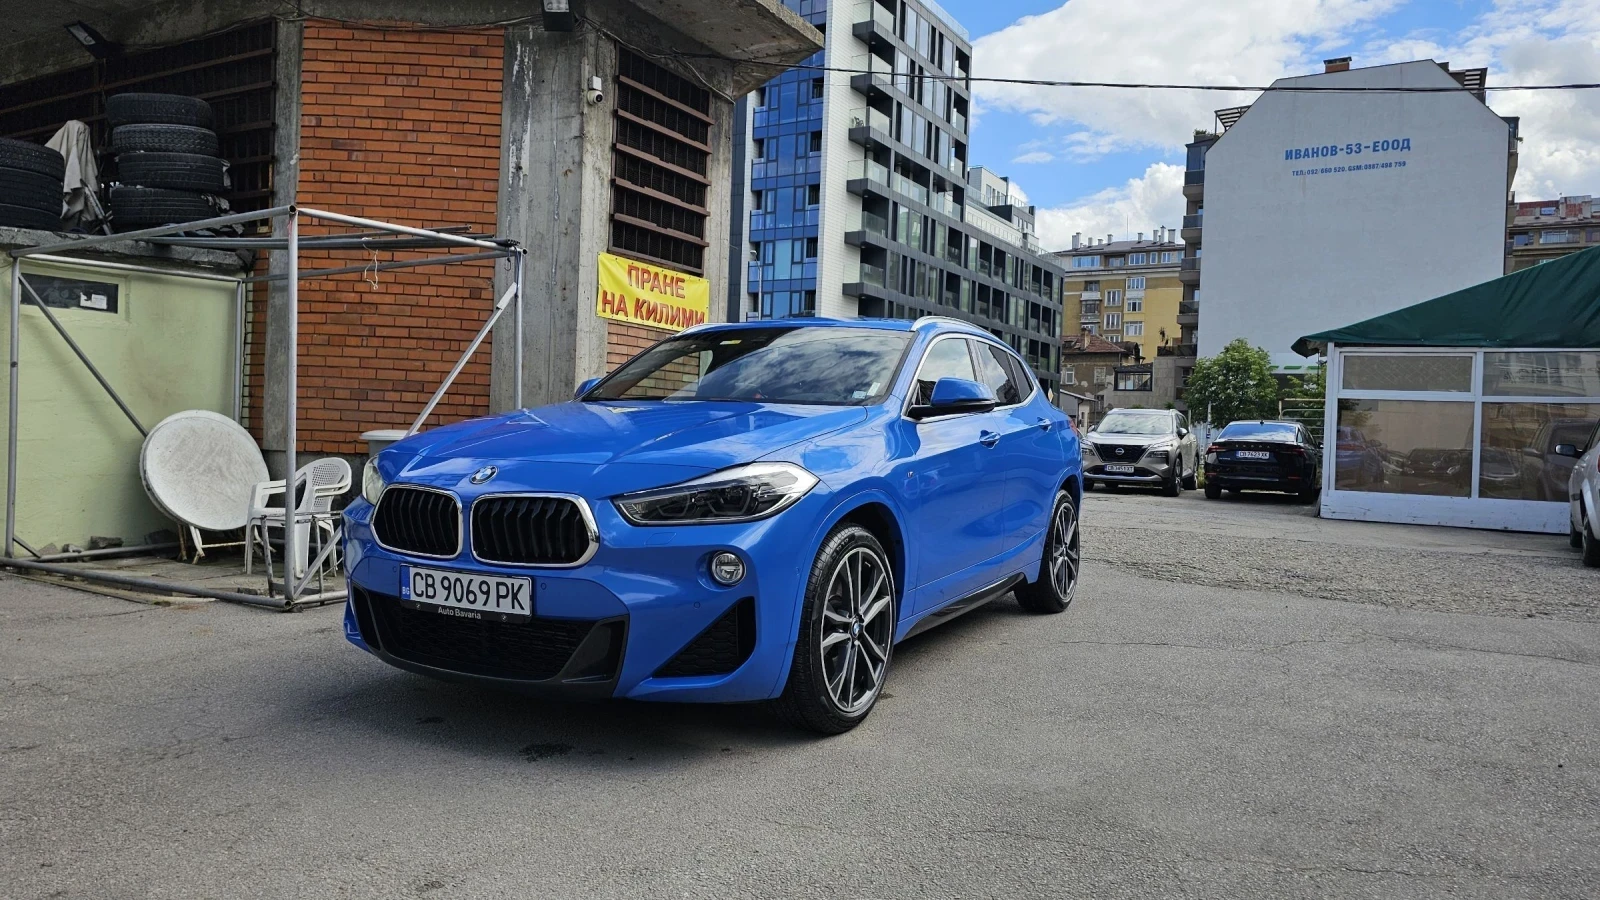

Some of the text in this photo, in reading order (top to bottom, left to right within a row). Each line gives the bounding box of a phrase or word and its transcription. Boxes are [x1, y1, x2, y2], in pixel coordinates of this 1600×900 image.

[627, 264, 686, 299] ПРАНЕ
[601, 290, 705, 328] НА КИЛИМИ
[402, 586, 411, 595] BG
[438, 606, 482, 620] Auto Bavaria
